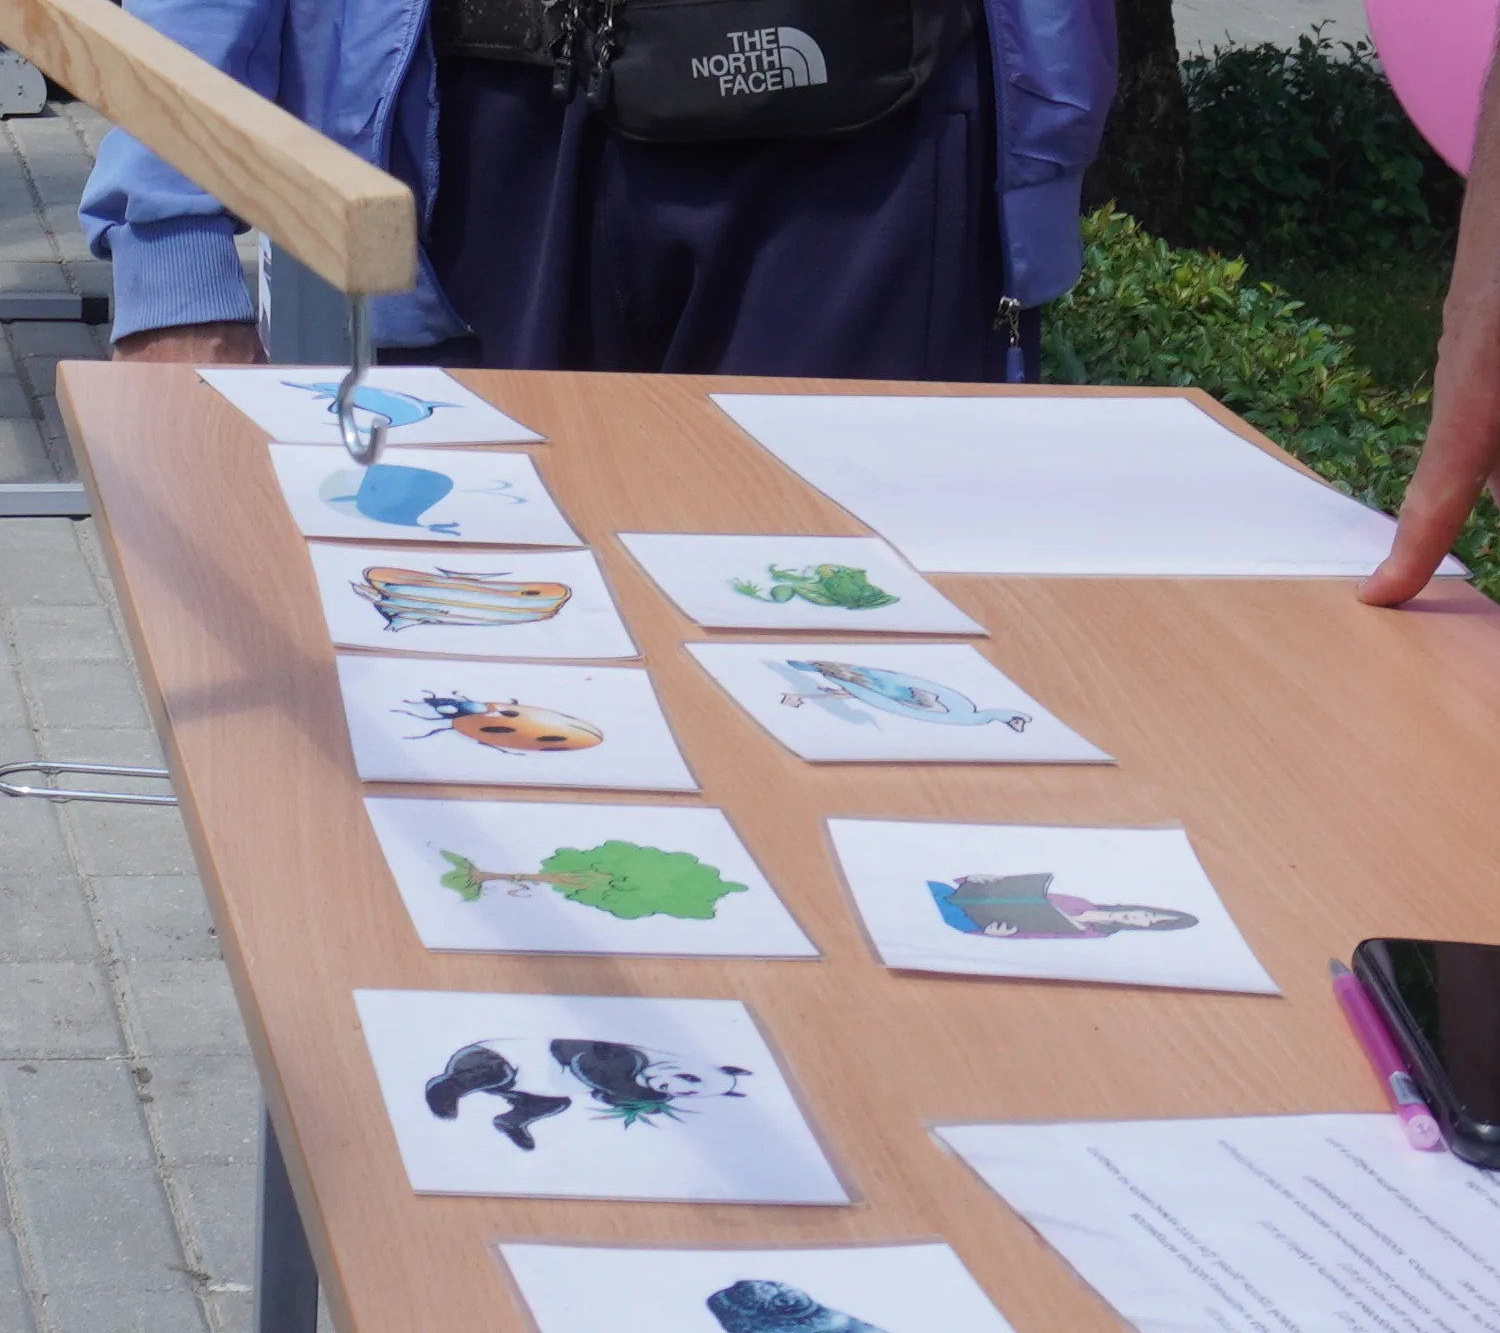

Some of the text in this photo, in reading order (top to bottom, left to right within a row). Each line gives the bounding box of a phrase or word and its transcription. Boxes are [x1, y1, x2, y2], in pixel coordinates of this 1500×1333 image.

[726, 27, 779, 51] THE
[692, 51, 780, 79] NORTH
[719, 68, 782, 97] FACE
